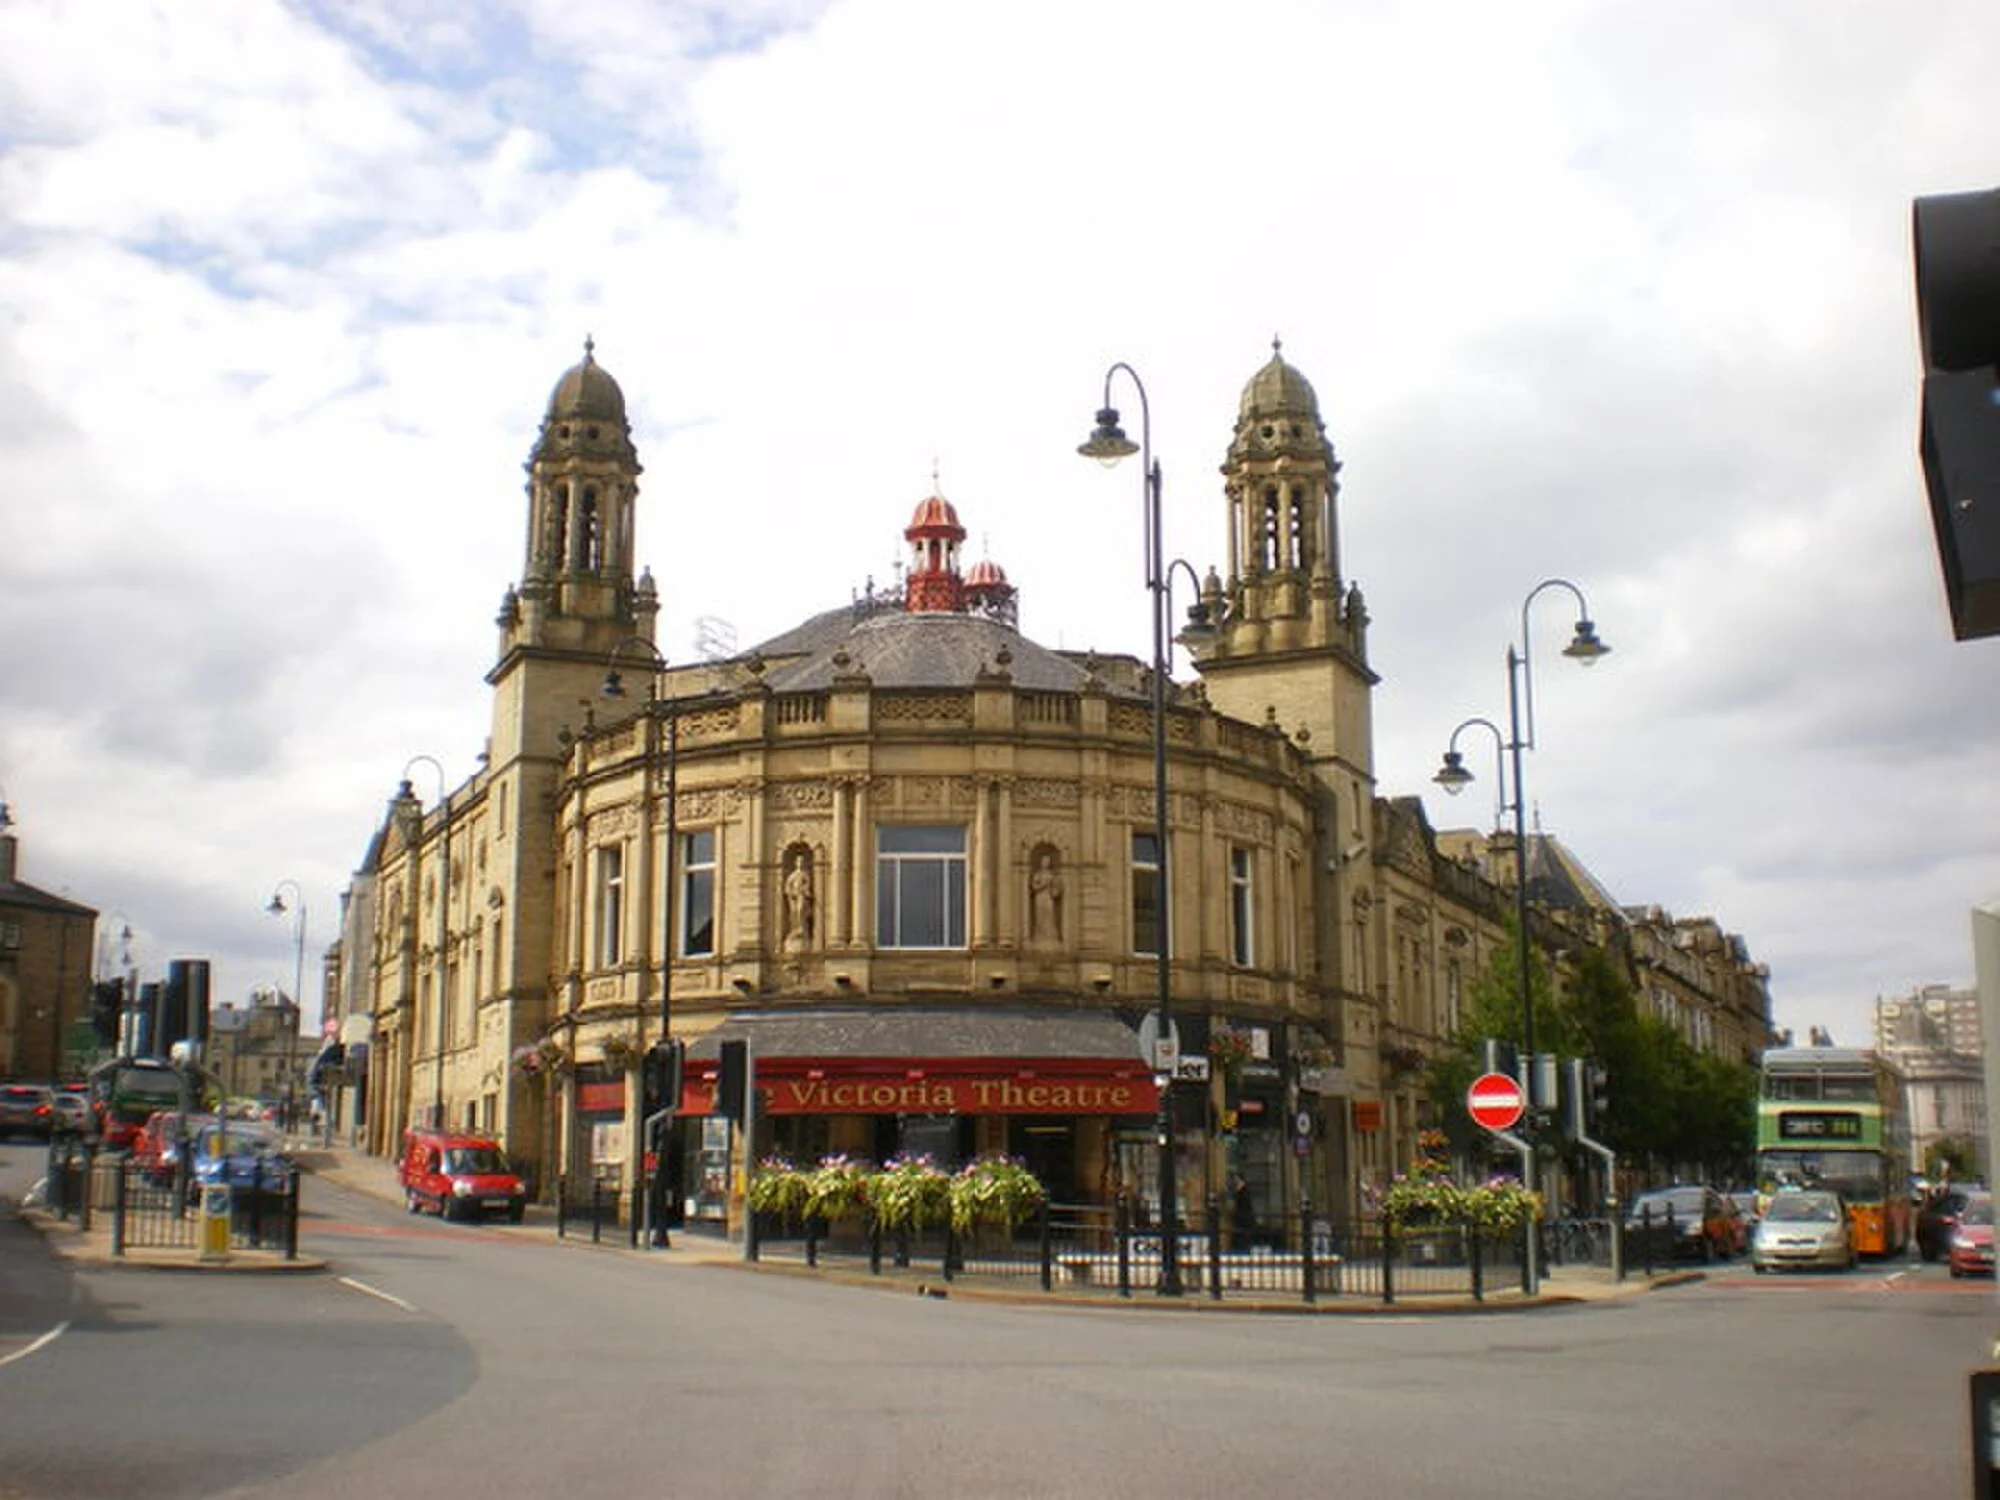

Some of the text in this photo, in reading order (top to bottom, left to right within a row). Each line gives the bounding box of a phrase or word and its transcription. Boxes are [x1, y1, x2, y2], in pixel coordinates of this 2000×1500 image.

[702, 1080, 1132, 1109] Te Victoria Theatre
